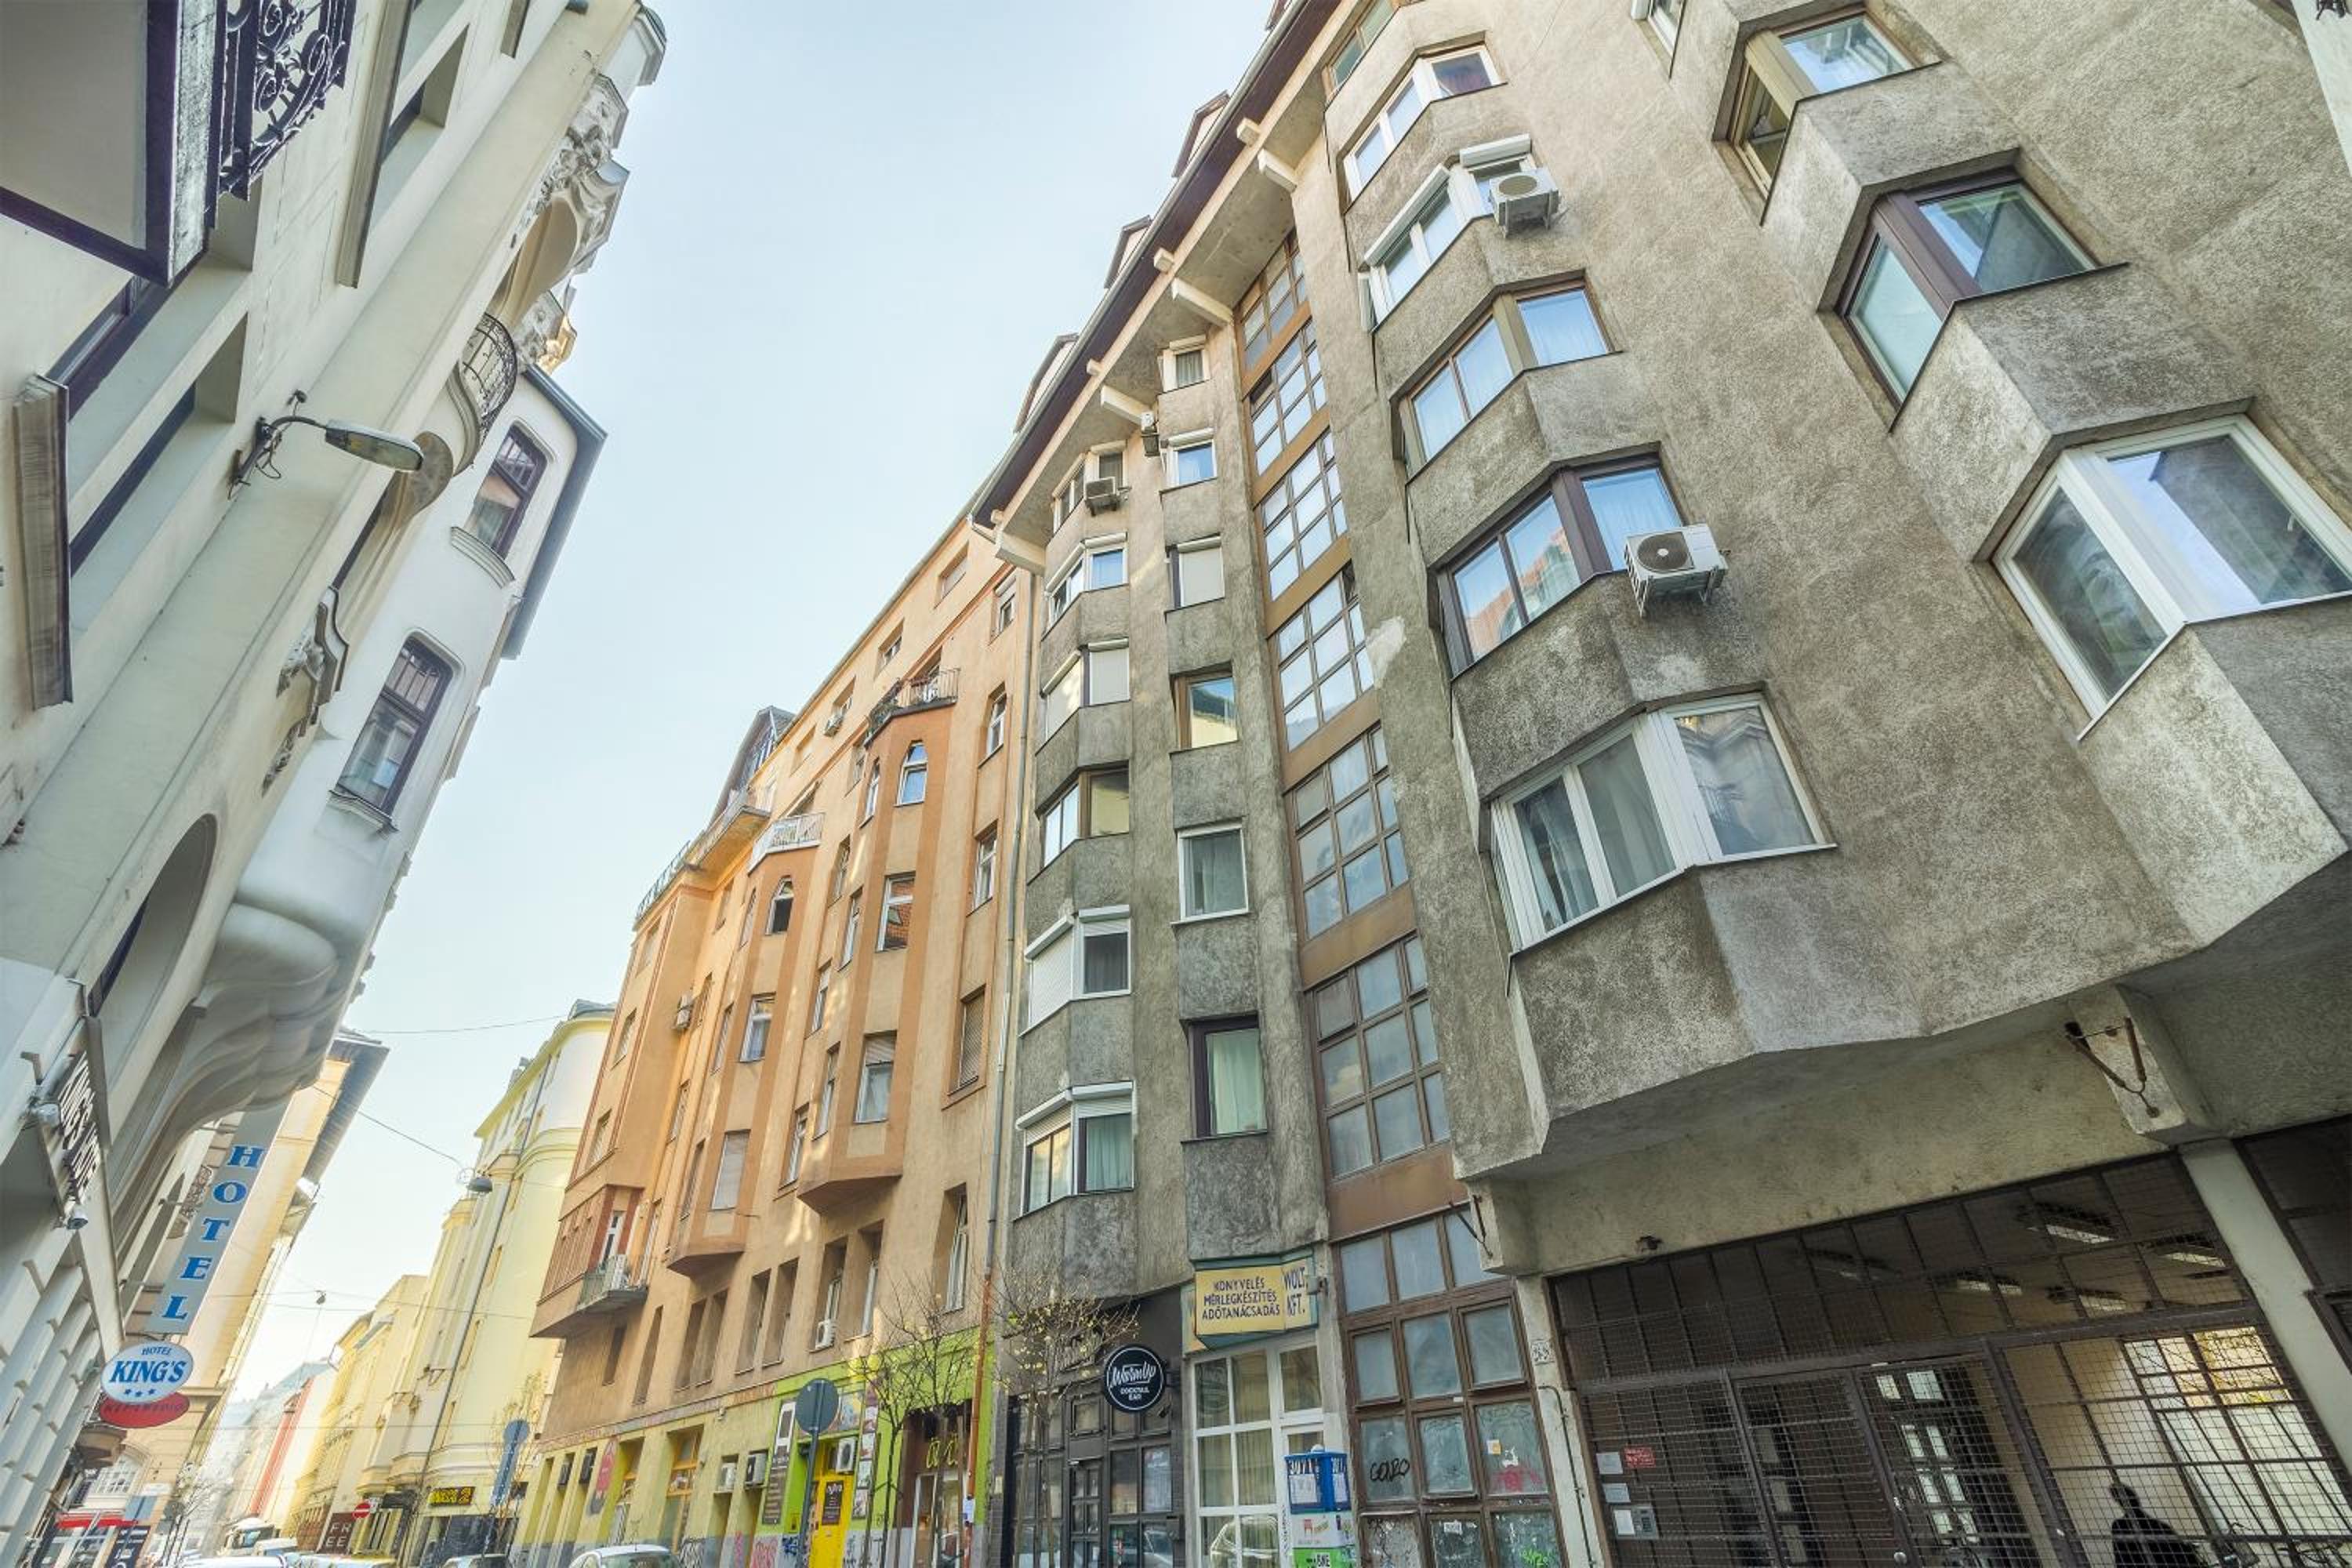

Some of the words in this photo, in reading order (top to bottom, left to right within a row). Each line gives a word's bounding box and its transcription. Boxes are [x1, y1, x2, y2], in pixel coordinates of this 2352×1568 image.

[162, 1145, 264, 1320] HOTEL
[142, 1346, 172, 1356] HOTEL
[109, 1360, 187, 1383] KING'S
